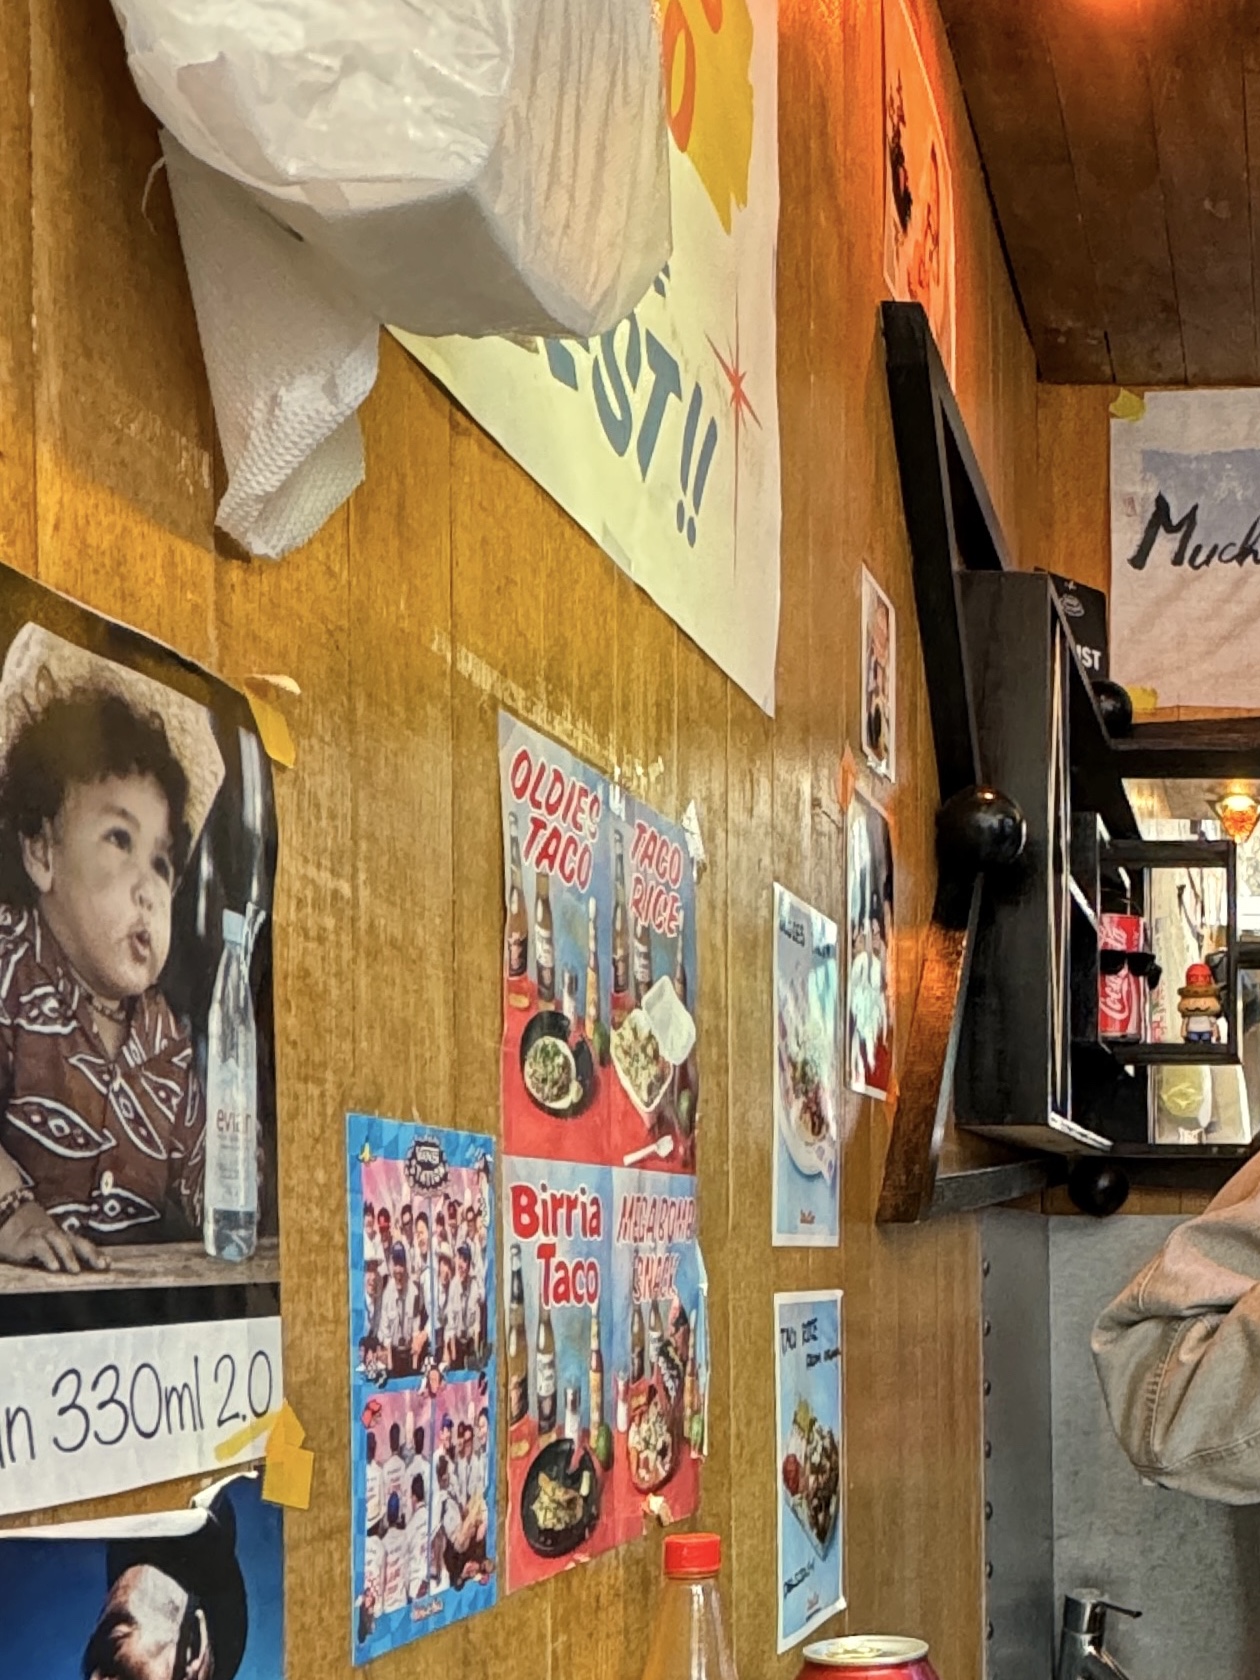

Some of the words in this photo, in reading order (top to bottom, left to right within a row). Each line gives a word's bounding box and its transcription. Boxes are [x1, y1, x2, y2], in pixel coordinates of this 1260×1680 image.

[511, 749, 601, 840] OLDIES
[523, 816, 593, 892] TACO
[631, 821, 683, 888] TACO
[630, 874, 681, 937] RICE
[511, 1183, 602, 1240] Birria
[536, 1242, 599, 1308] Taco
[51, 1355, 205, 1453] 330ml
[214, 1350, 273, 1423] 2.0
